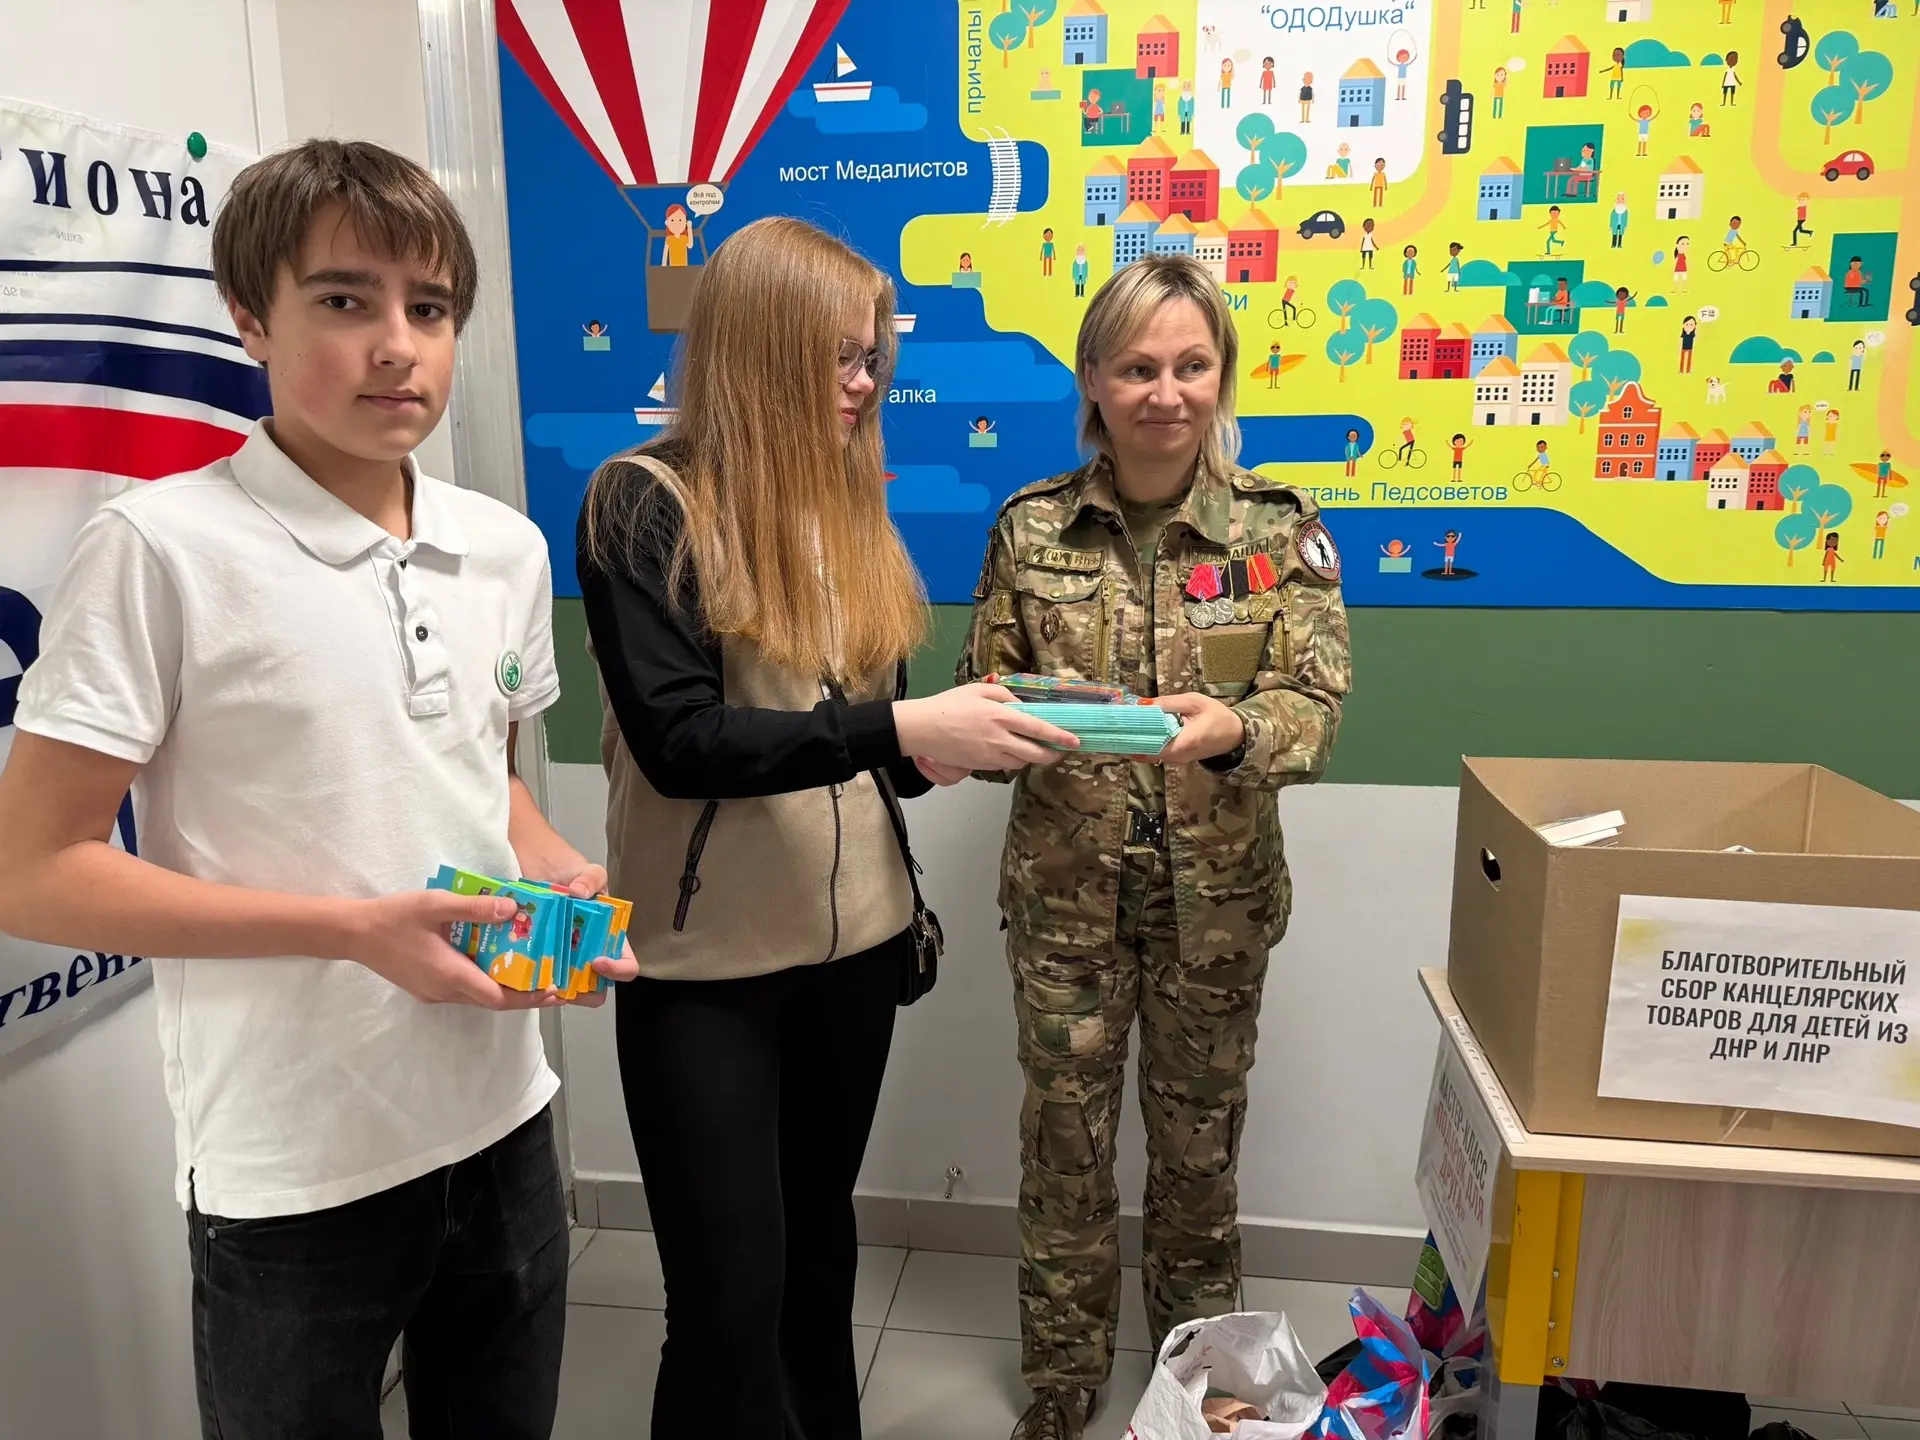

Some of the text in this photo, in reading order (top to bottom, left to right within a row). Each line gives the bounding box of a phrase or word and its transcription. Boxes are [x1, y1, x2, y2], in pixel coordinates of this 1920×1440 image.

[967, 10, 986, 114] причалы
[0, 147, 210, 228] иона
[779, 160, 968, 183] мост Медалистов
[1371, 482, 1508, 504] Педсоветов
[1661, 950, 1907, 985] БЛАГОТВОРИТЕЛЬНЫЙ
[1660, 978, 1899, 1014] СБОР КАНЦЕЛЯРСКИХ
[1647, 1005, 1909, 1044] ТОВАРОВ ДЛЯ ДЕТЕЙ ИЗ
[1710, 1037, 1831, 1064] ДНР И ЛНР
